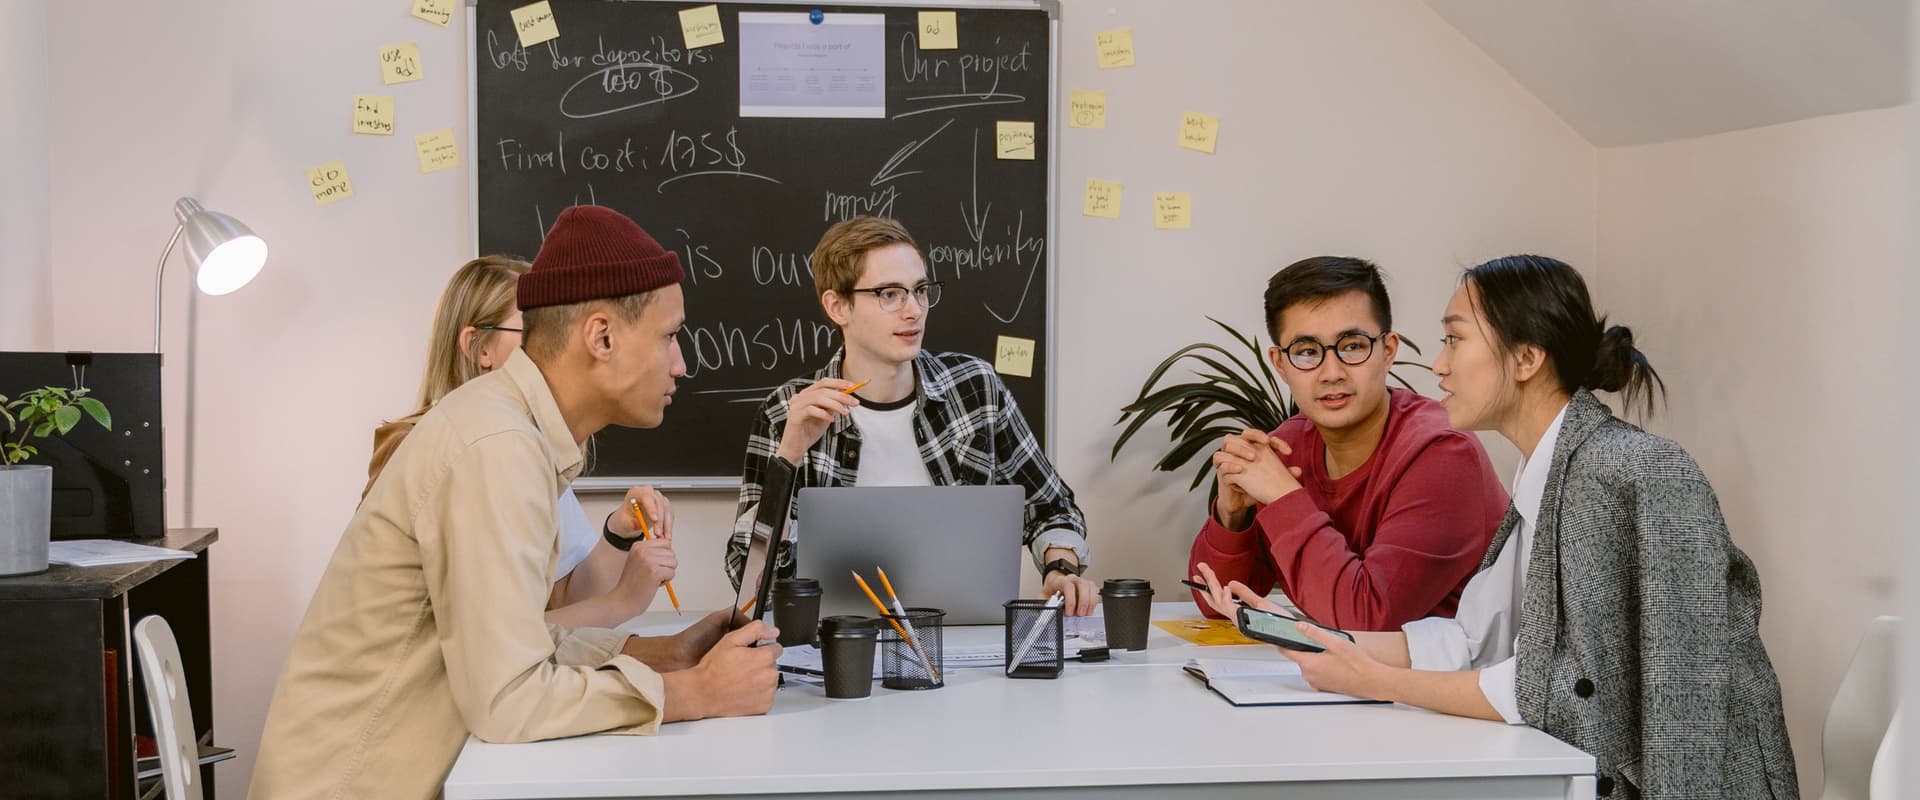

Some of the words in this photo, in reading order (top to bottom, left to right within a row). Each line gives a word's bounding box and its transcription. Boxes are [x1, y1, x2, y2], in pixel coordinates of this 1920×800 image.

[901, 31, 949, 82] Our
[959, 36, 1032, 100] project
[497, 131, 567, 175] Final
[675, 228, 723, 285] is
[929, 209, 1044, 324] popularity
